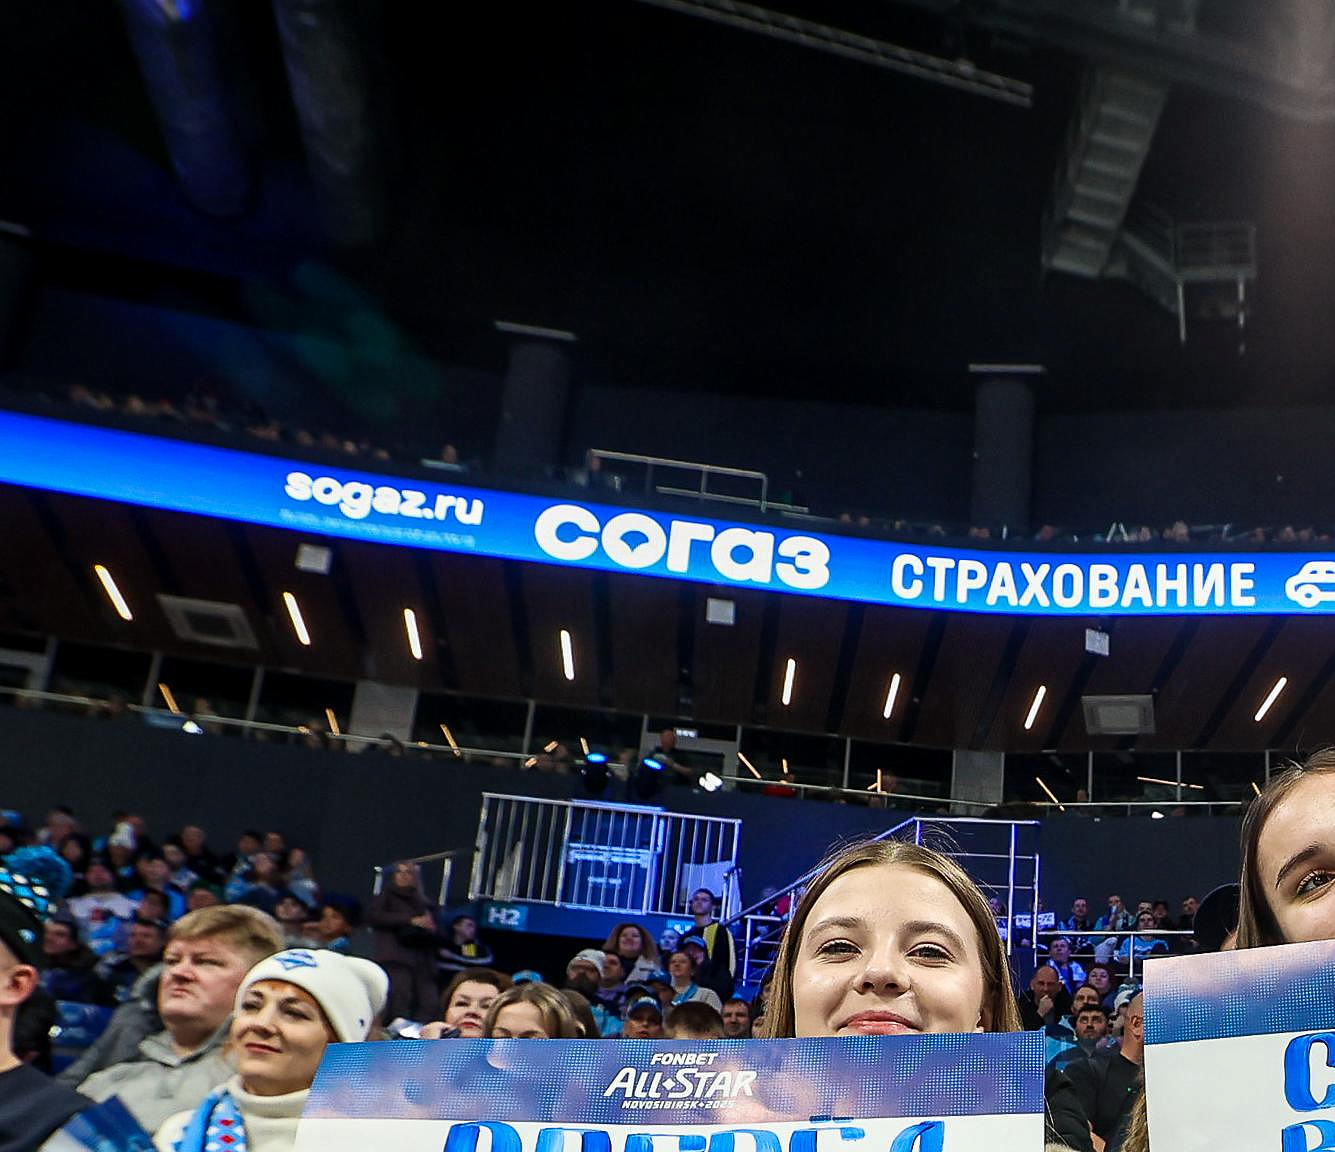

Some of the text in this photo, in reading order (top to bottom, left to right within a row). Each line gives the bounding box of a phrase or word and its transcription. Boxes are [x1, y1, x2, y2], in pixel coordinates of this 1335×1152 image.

[284, 471, 485, 526] sogaz.ru
[890, 553, 1256, 609] СТРАХОВАНИЕ
[650, 1052, 719, 1066] FONBET
